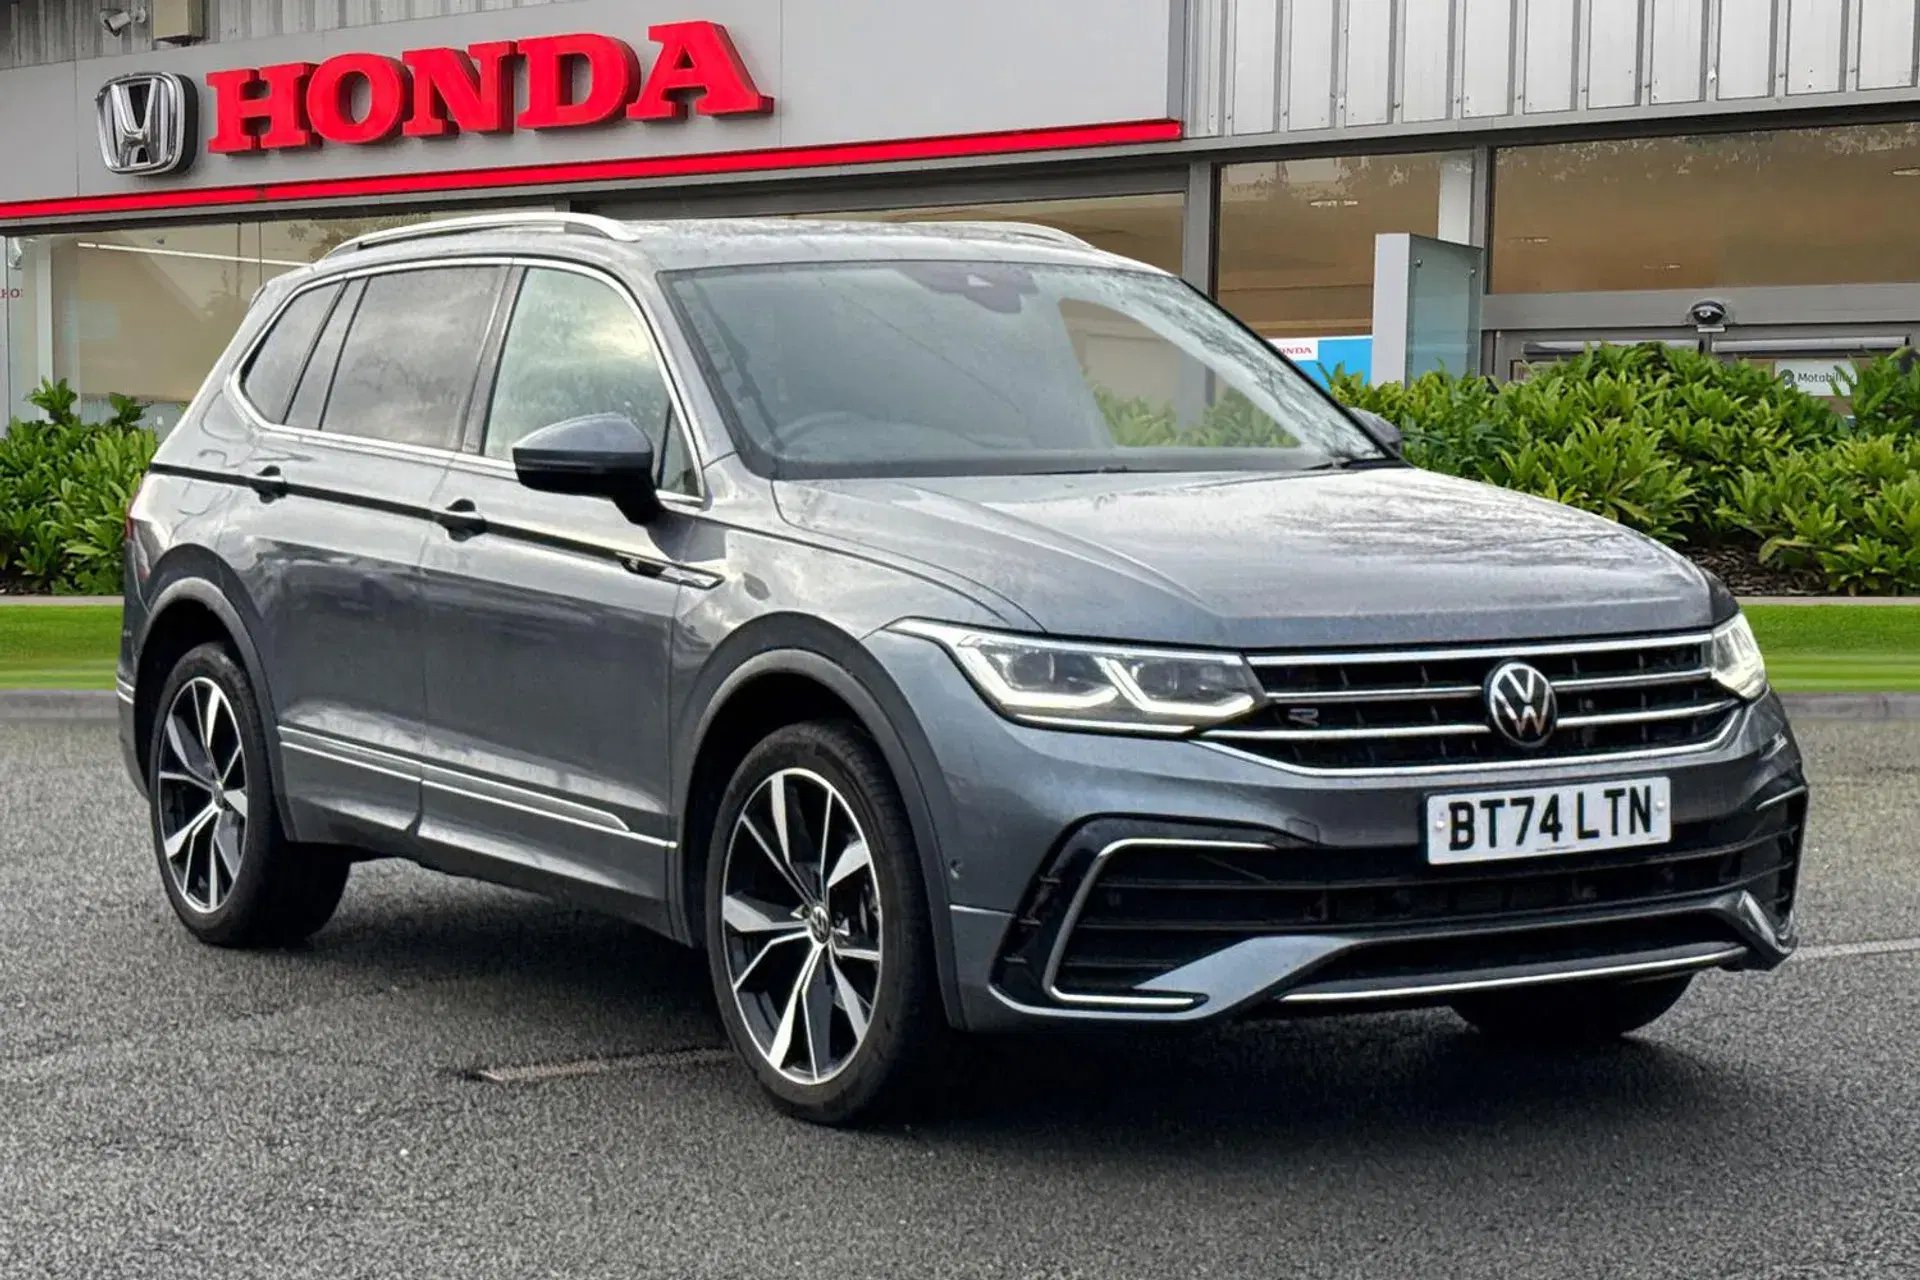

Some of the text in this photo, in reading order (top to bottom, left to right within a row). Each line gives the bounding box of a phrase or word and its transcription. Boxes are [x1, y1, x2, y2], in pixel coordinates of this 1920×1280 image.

[206, 20, 773, 154] HONDA
[1449, 785, 1651, 851] BT74 LTN
